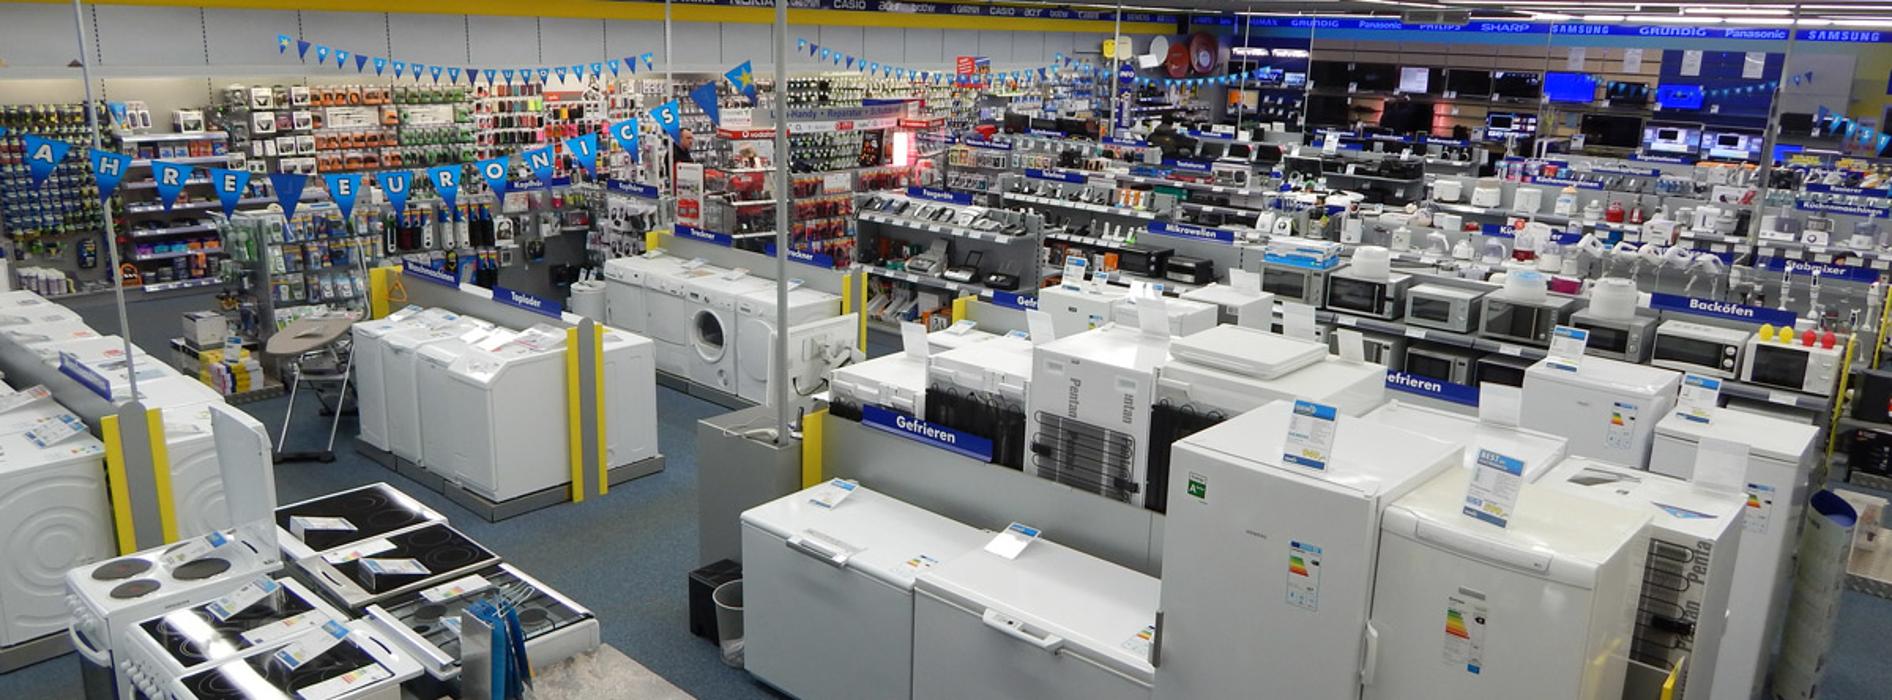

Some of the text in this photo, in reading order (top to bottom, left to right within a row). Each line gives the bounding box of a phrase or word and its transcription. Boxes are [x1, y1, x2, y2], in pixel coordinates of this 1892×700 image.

[833, 0, 866, 10] CASIO
[989, 7, 1015, 16] CASIO
[1291, 19, 1340, 28] GRUNDIG
[1358, 20, 1402, 30] Panasonic
[1419, 23, 1461, 31] PHILIPS
[1481, 22, 1530, 33] SHARP
[1552, 24, 1609, 35] SAMSUNG
[1639, 25, 1707, 37] GRUNDIG
[1724, 27, 1786, 39] Panasonic
[1807, 30, 1881, 42] SAMSUNG
[1165, 223, 1217, 239] Mikrowellen
[787, 248, 814, 262] rockner
[1785, 259, 1847, 276] Stabmixer
[511, 291, 543, 308] Toplader
[1689, 298, 1755, 318] Backöfen
[1387, 372, 1442, 393] efrieren
[896, 415, 956, 444] Gefrieren
